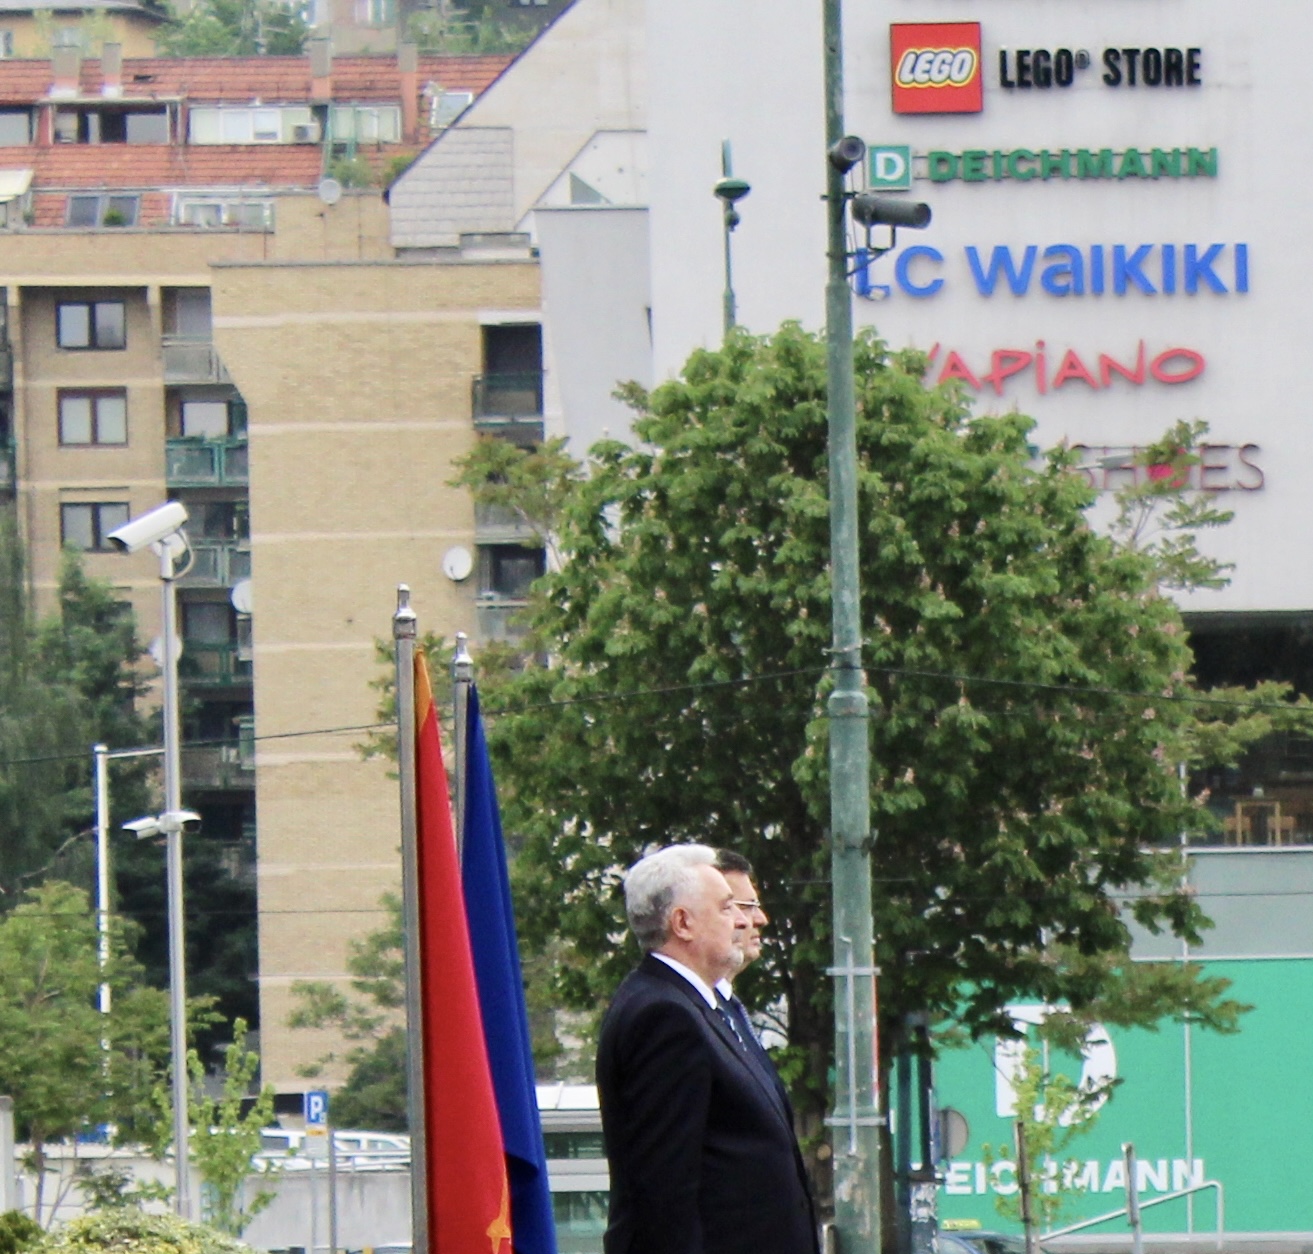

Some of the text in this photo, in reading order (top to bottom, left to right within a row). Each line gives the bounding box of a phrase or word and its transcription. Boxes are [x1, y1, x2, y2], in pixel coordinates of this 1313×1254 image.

[899, 50, 975, 84] LEGO
[1102, 46, 1202, 88] STORE
[876, 146, 1218, 184] D DEICHMANN
[854, 244, 945, 299] LC
[911, 1158, 1204, 1195] EICHMANN
